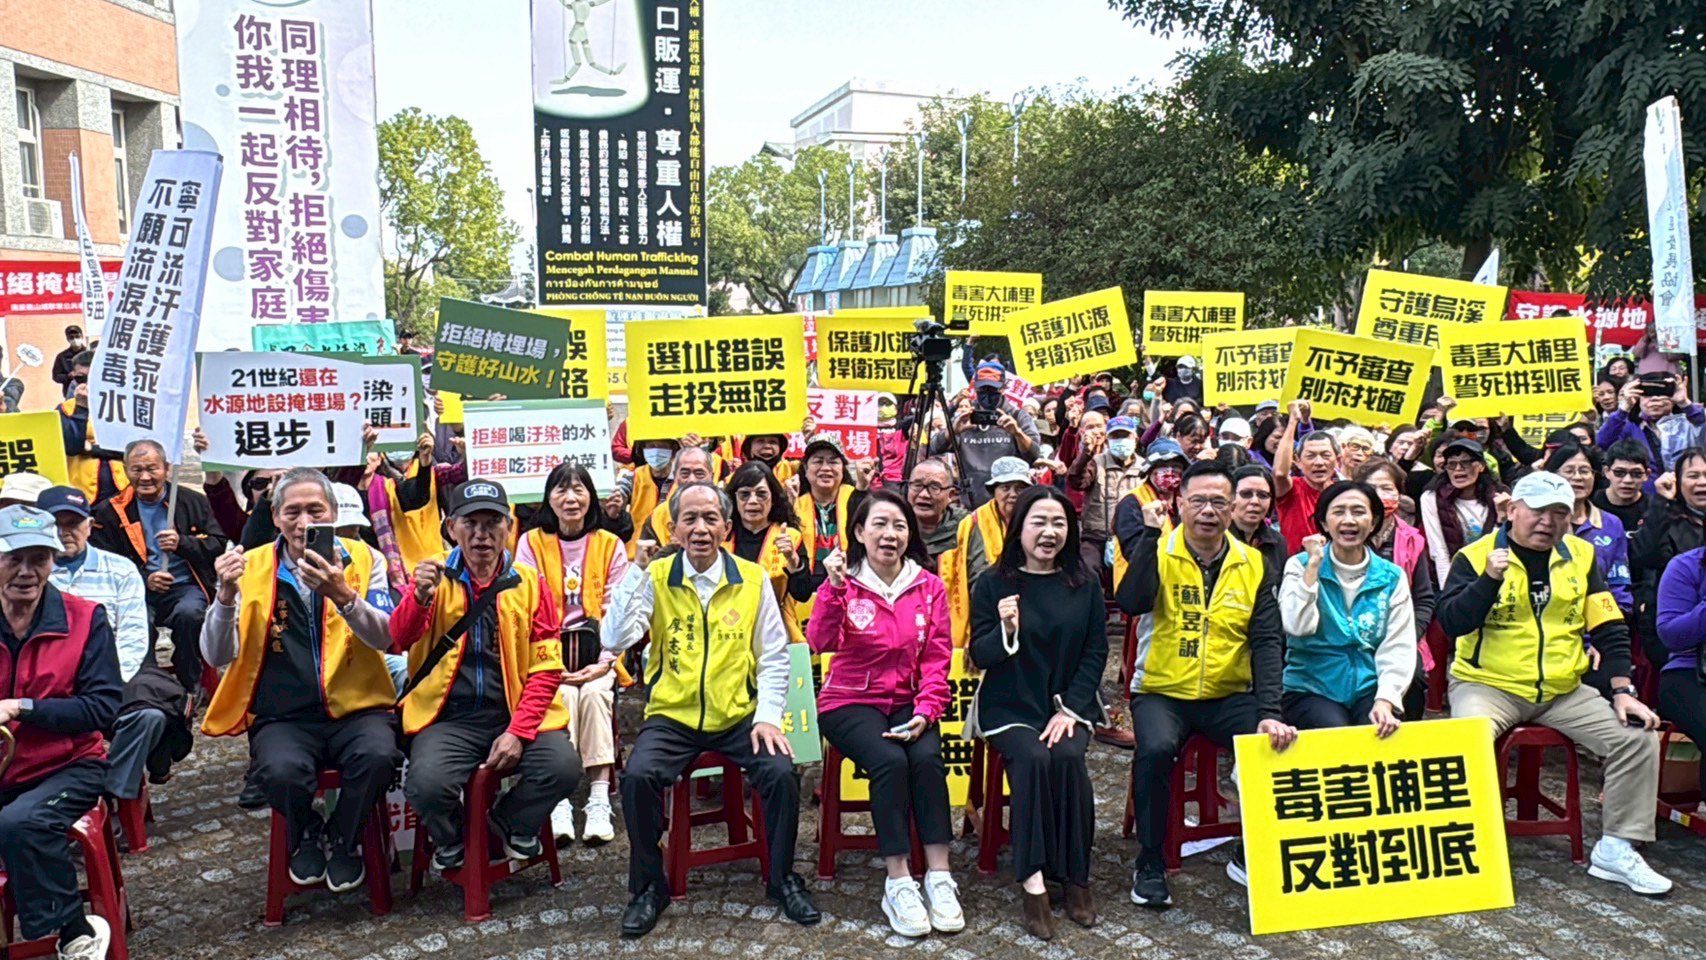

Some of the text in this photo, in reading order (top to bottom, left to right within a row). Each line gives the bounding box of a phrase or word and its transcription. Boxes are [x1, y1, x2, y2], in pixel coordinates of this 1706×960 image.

[233, 14, 287, 320] 你我一起反對家庭
[545, 251, 699, 264] Combat Human Trafficking
[546, 265, 698, 278] Mencegah Perdagangan Manusia
[97, 178, 177, 424] 不願流淚喝毒水
[952, 284, 1035, 303] 毒害大埔里
[1020, 305, 1111, 346] 保護水源
[1150, 305, 1236, 324] 毒害大埔里
[440, 322, 561, 360] 拒絕掩埋場，
[647, 337, 785, 376] 選址錯誤
[1025, 331, 1117, 372] 捍衛家園
[1450, 337, 1579, 369] 毒害大埔里
[232, 367, 338, 389] 21世紀還在
[436, 351, 556, 389] 守護好山水！
[1305, 346, 1415, 386] 不予審查
[1453, 368, 1582, 399] 誓死拼到底
[204, 392, 362, 414] 水源地設掩埋場？
[649, 378, 787, 417] 走投無路
[235, 420, 337, 458] 退步！
[1179, 584, 1202, 658] 蘇昱誠
[1272, 755, 1472, 823] 毒害埔里
[1279, 821, 1480, 895] 反對到底
